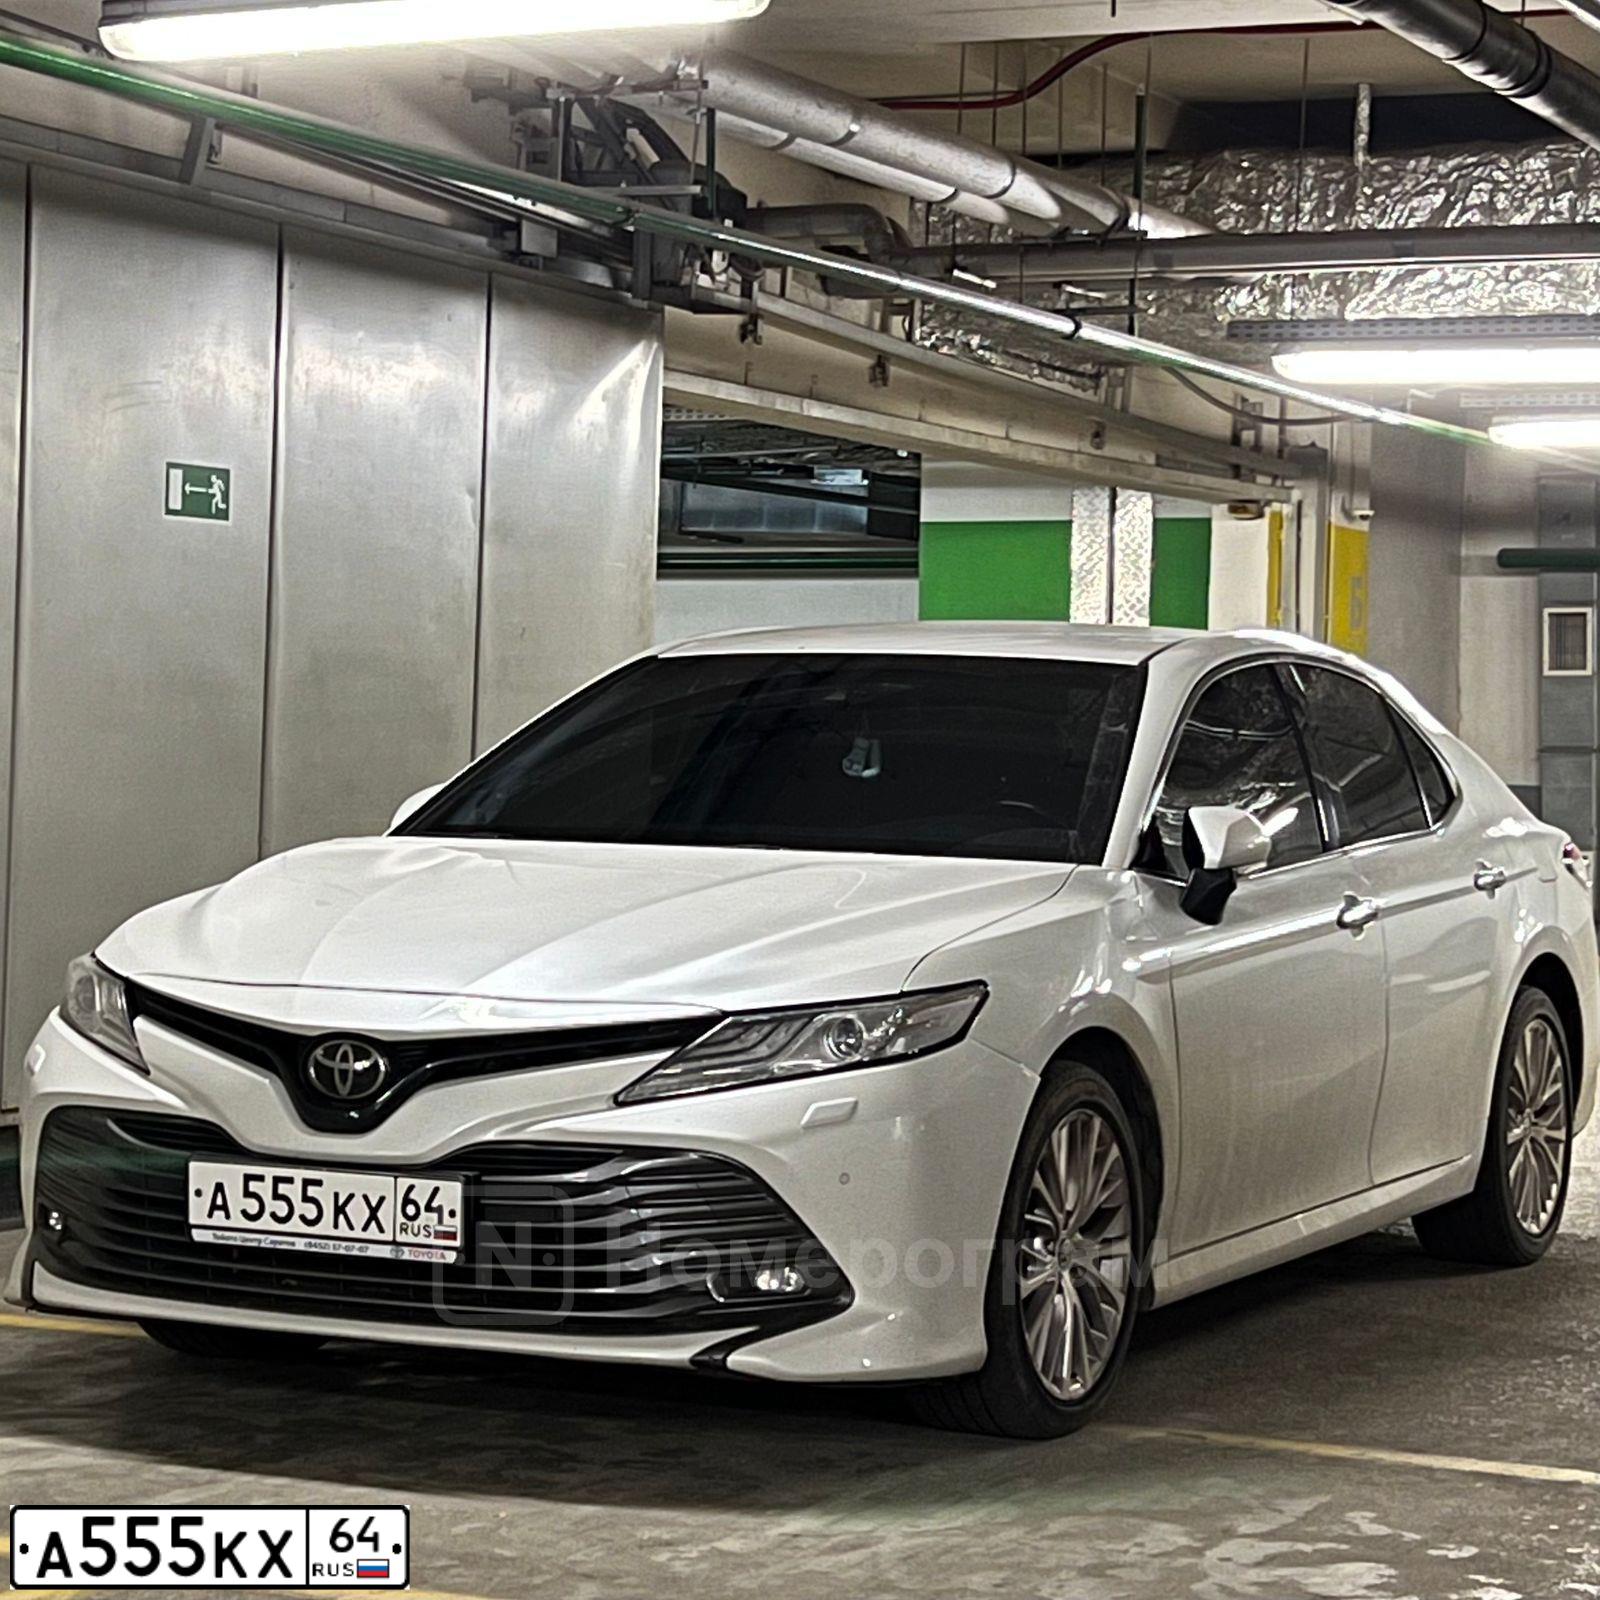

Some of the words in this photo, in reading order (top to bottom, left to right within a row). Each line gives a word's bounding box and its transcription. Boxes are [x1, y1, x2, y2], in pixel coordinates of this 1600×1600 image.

[400, 1184, 444, 1225] 64
[399, 1222, 432, 1238] RUS
[408, 1249, 446, 1261] TOYOTA
